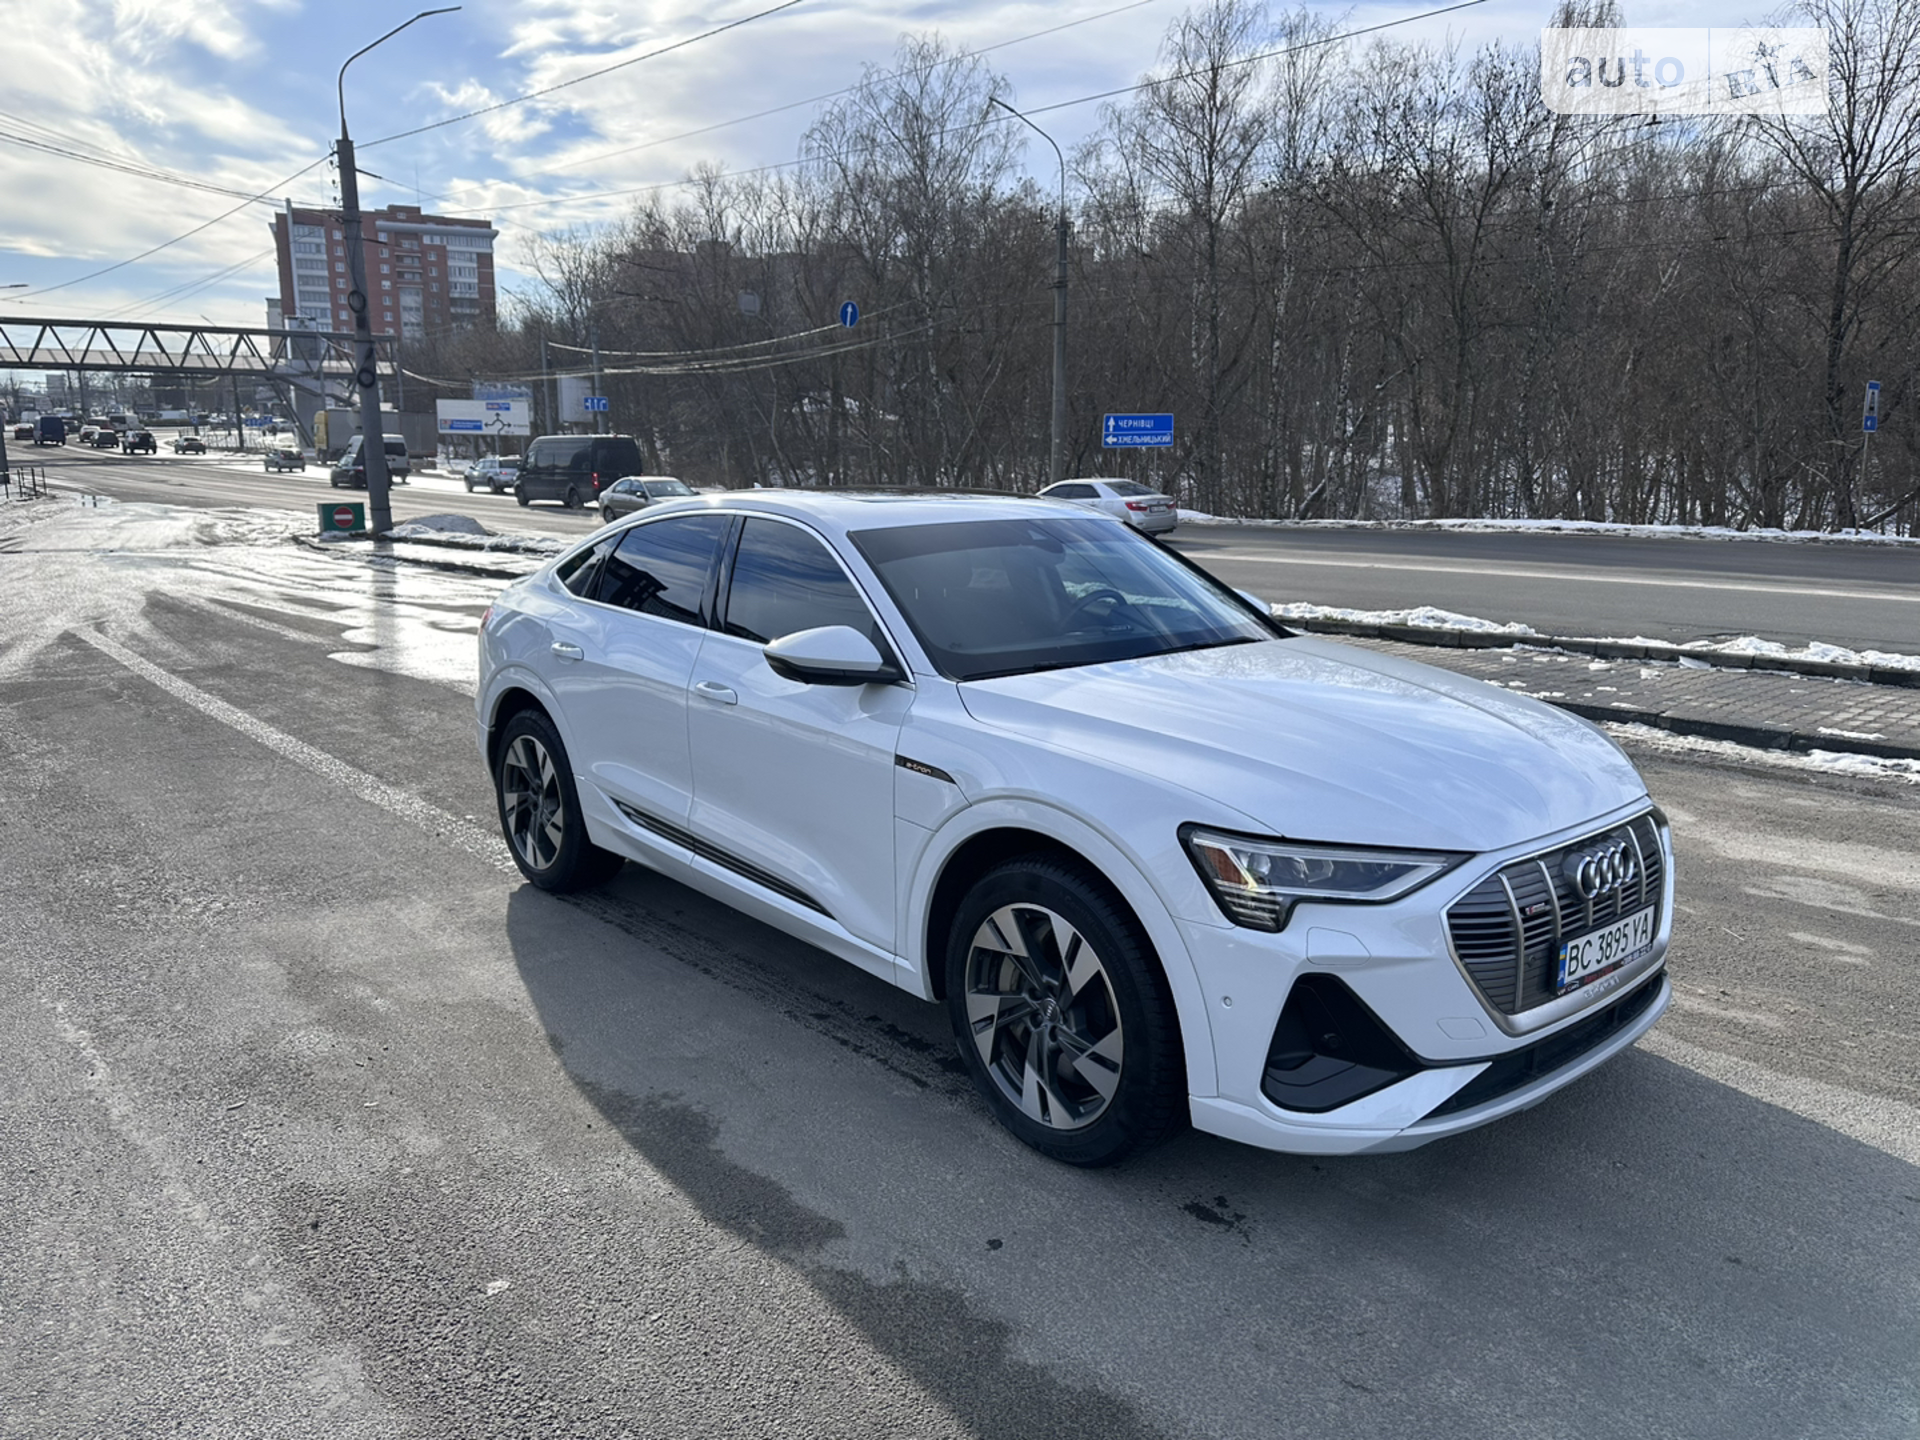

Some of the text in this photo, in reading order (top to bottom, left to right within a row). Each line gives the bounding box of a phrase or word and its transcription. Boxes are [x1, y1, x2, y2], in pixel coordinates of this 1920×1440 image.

[1118, 419, 1154, 429] ЧЕРНІВЦІ
[1117, 433, 1172, 444] ХМЕЛЬНИЦЬКИЙ
[906, 762, 931, 775] e-tron
[1567, 939, 1593, 977] BC
[1596, 923, 1629, 965] 3895
[1632, 913, 1649, 947] YA
